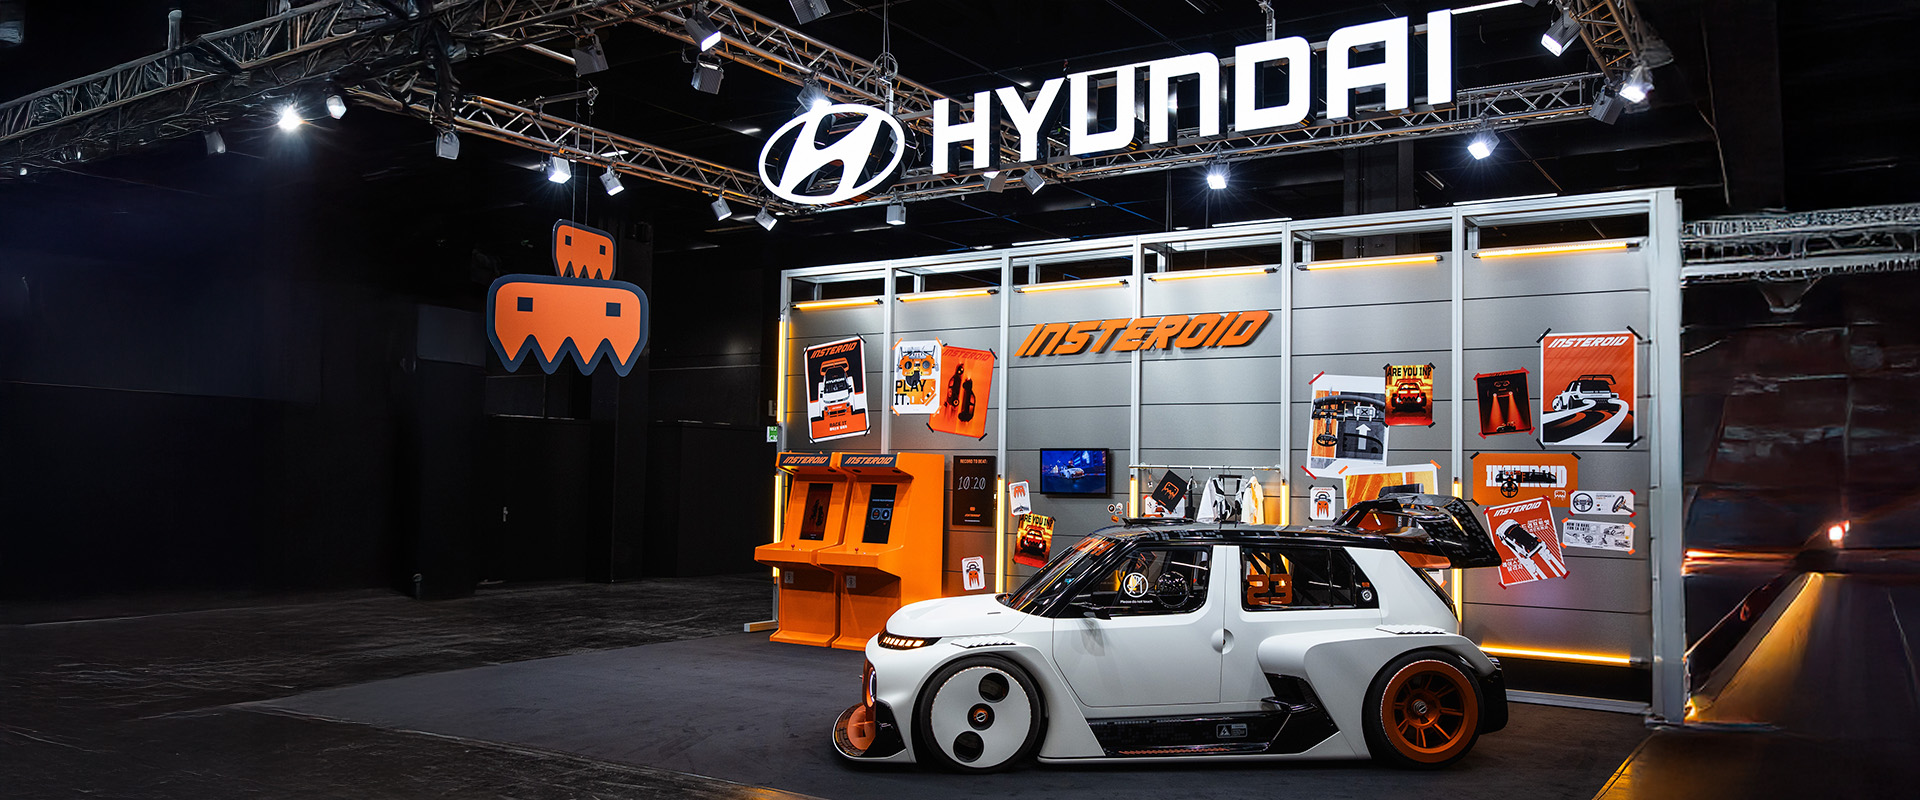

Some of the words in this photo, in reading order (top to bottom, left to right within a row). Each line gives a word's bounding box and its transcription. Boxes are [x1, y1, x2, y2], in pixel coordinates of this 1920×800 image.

[933, 9, 1452, 174] HYUNDAI
[1014, 310, 1270, 357] INSTEROID
[1548, 336, 1629, 348] INSTEROID
[810, 342, 858, 359] INSTEROID
[942, 348, 991, 361] INSTEROID
[1386, 367, 1401, 377] ARE
[1403, 367, 1417, 377] YOU
[1419, 367, 1432, 377] IN?
[895, 380, 926, 392] PLAY
[895, 393, 910, 405] IT.
[783, 456, 828, 464] INSTEROID
[845, 456, 894, 465] INSTEROID
[958, 476, 986, 490] 10:20
[1493, 501, 1542, 517] INSTEROID
[1247, 574, 1292, 605] 23
